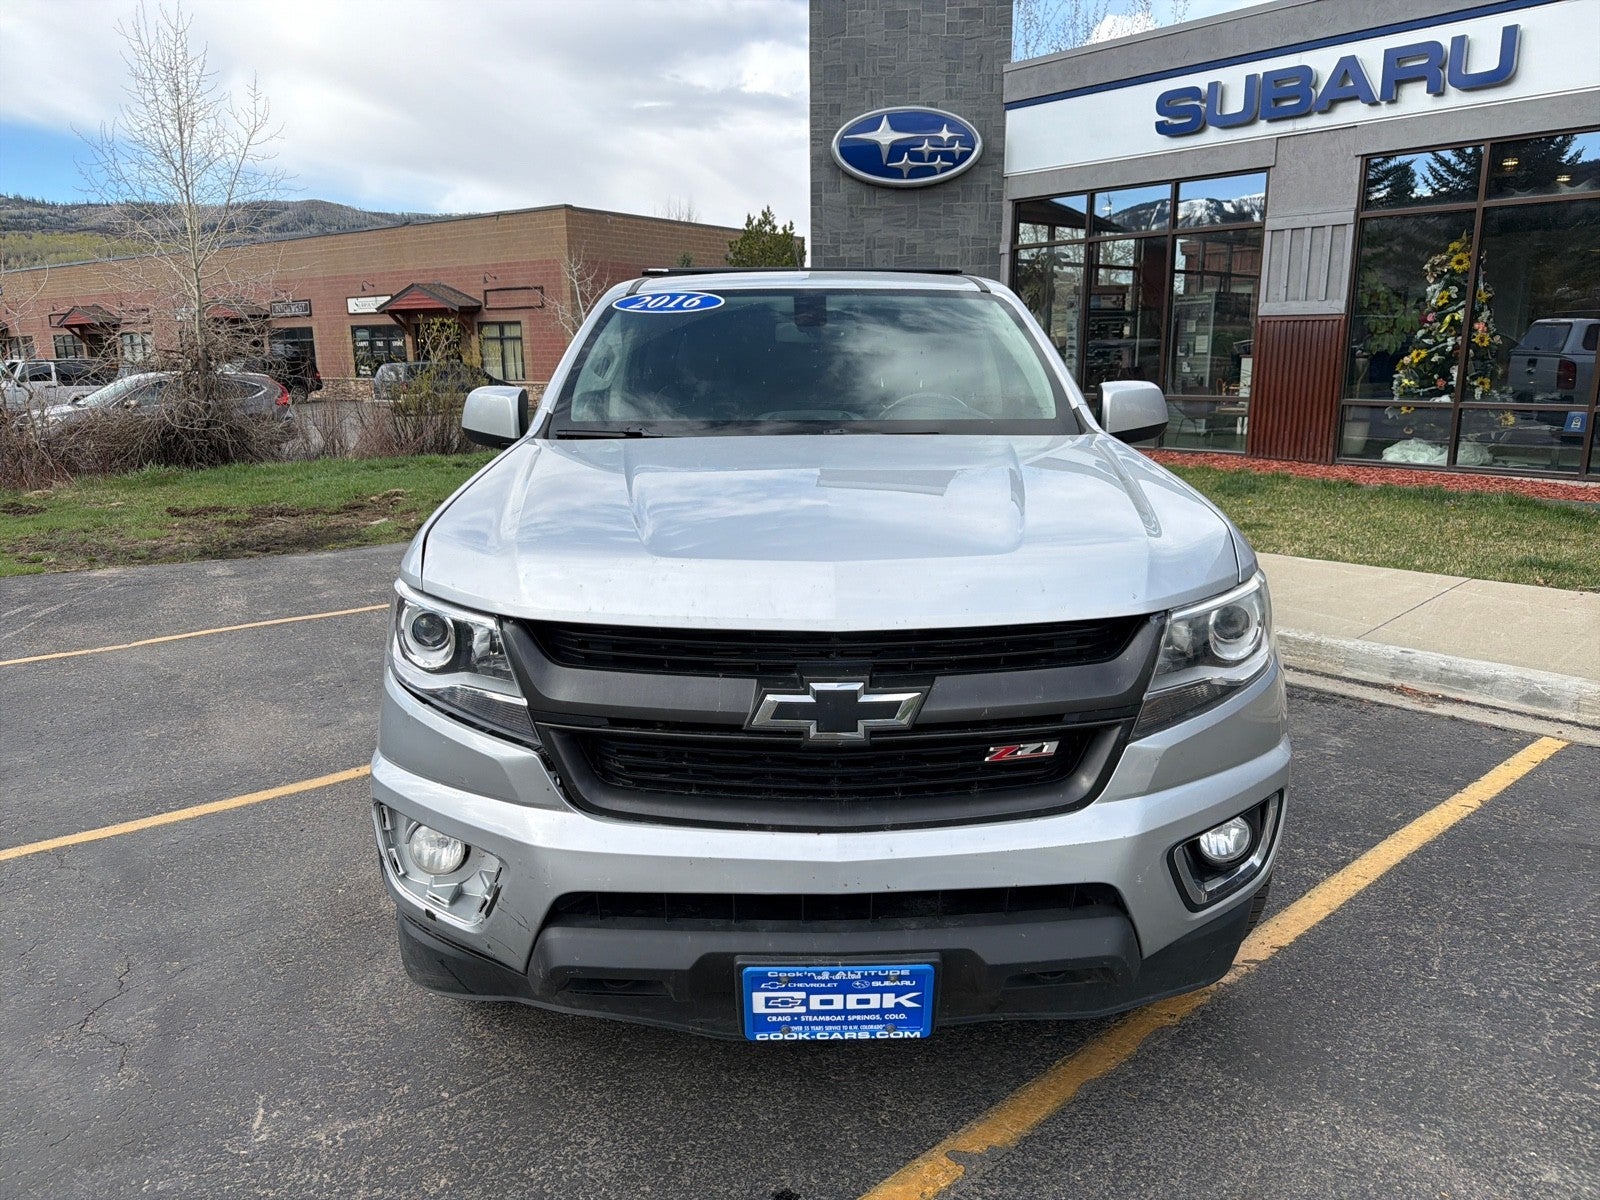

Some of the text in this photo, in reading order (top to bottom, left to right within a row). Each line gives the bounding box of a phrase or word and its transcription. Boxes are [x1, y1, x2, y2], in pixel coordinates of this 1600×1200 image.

[1155, 23, 1521, 137] SUBARU
[626, 295, 708, 309] 2016
[984, 741, 1060, 761] Z71
[836, 969, 911, 978] ALTITUDE
[752, 991, 923, 1014] COOK
[801, 1014, 845, 1022] STEAMBOAT
[848, 1013, 882, 1021] SPRINGS,
[756, 1031, 921, 1041] COOK-CARS.COM
